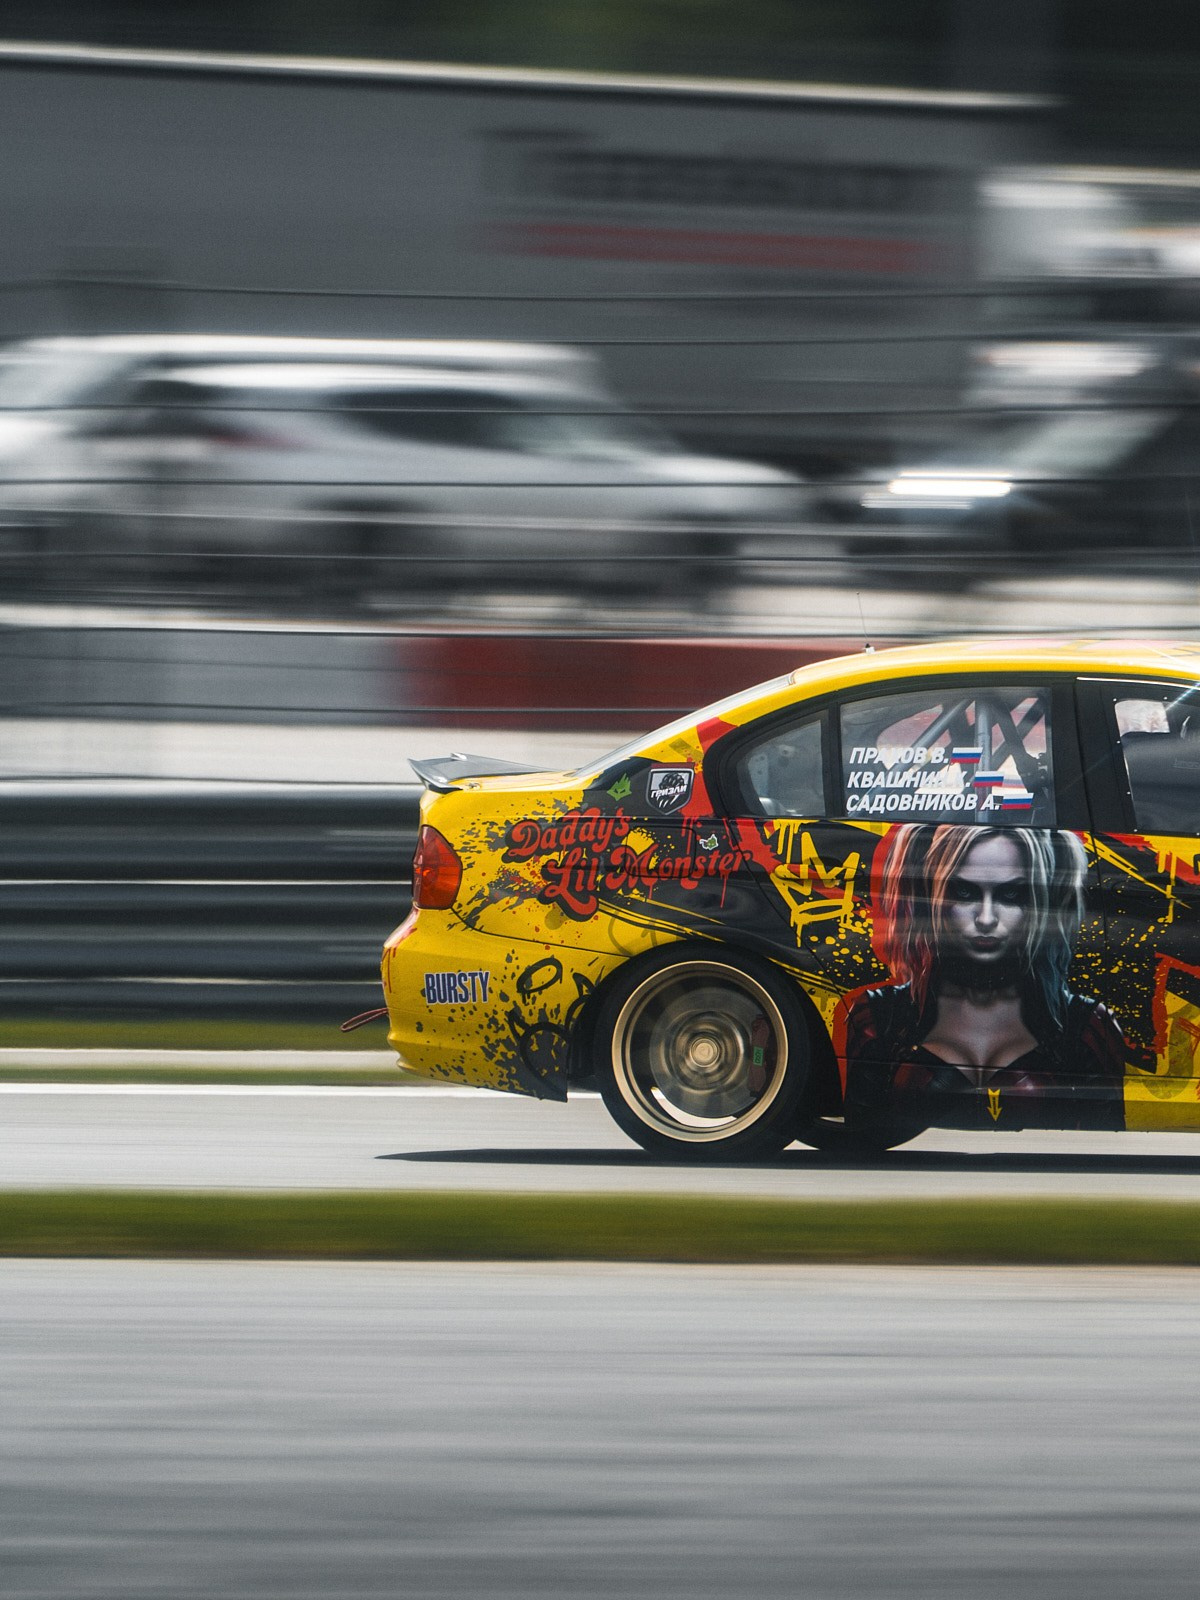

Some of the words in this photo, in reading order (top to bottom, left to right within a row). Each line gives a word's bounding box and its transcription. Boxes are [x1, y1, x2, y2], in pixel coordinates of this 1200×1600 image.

[651, 785, 687, 799] ГРИЗЛИ
[846, 794, 978, 814] САДОВНИКОВ
[981, 794, 1001, 811] А.
[509, 808, 630, 857] Daddy's
[544, 847, 599, 915] Lil
[605, 844, 751, 890] Monster
[425, 971, 490, 1004] BURSTY
